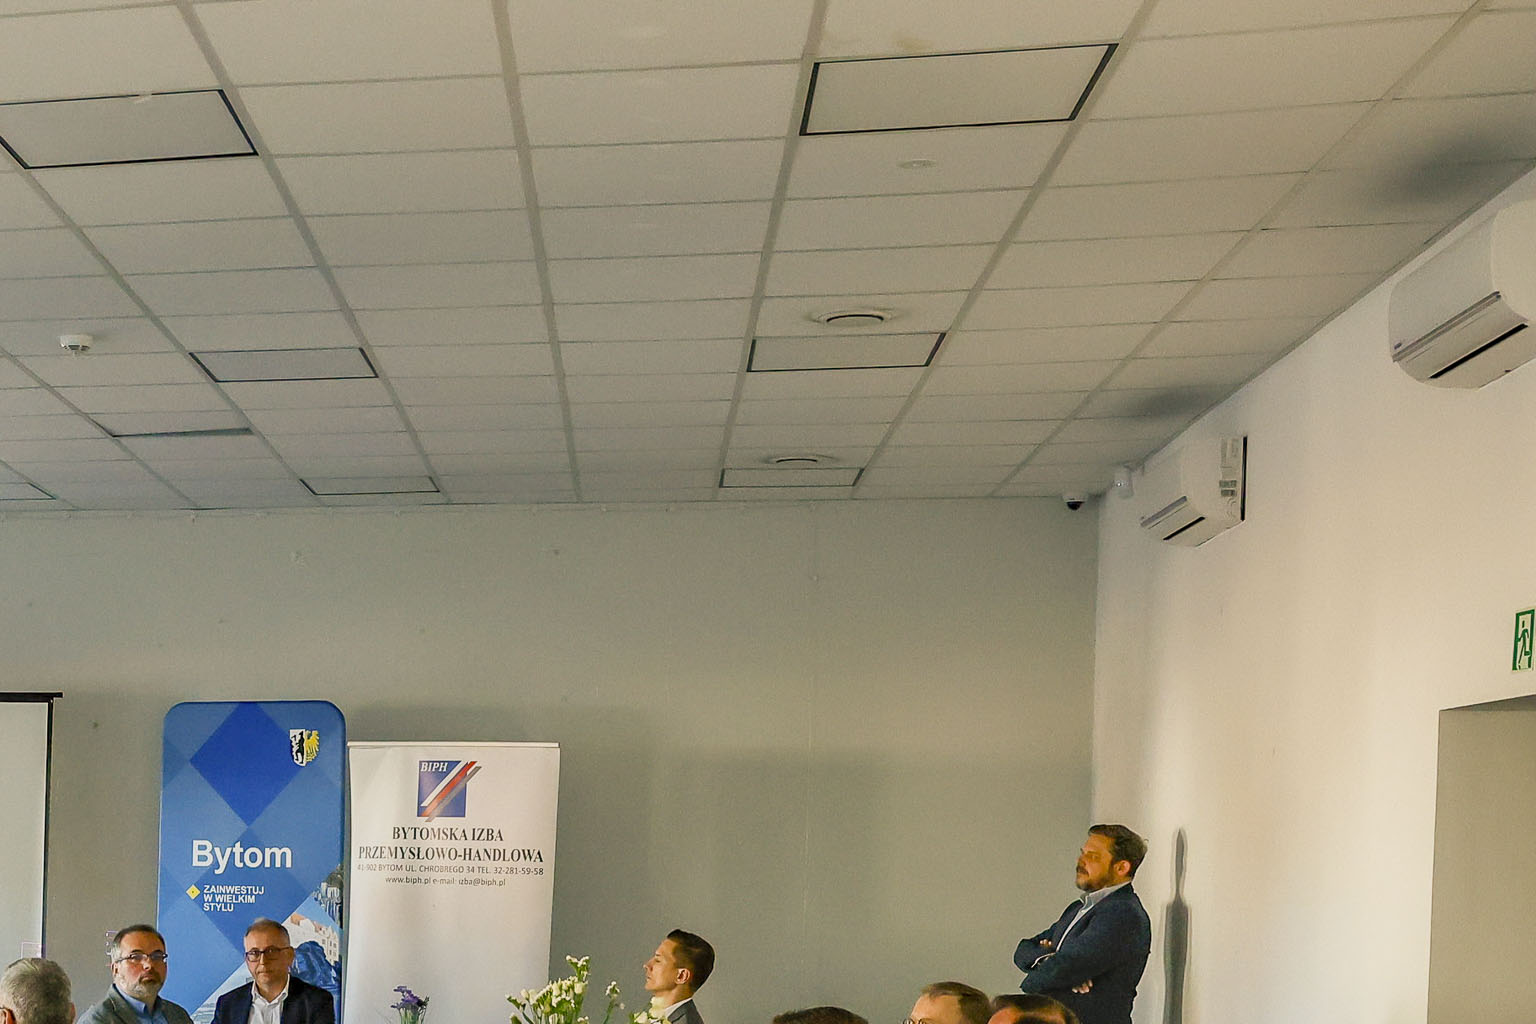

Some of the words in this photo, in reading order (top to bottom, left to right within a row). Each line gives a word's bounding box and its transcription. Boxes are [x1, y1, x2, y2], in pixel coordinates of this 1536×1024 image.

[420, 762, 448, 772] BIPH
[392, 826, 468, 841] BYTOMSKA
[471, 827, 504, 842] IZBA
[191, 839, 293, 875] Bytom
[378, 864, 404, 872] BYTOM
[419, 864, 464, 874] CHROBREGO
[466, 866, 475, 874] 34
[493, 866, 544, 876] 32-281-59-58
[385, 876, 431, 885] www.biph.pl
[458, 877, 506, 887] izba@biph.pl
[203, 884, 265, 895] ZAINWESTUJ
[203, 894, 213, 903] W
[215, 894, 256, 904] WIELKIM
[203, 902, 234, 912] STYLU
